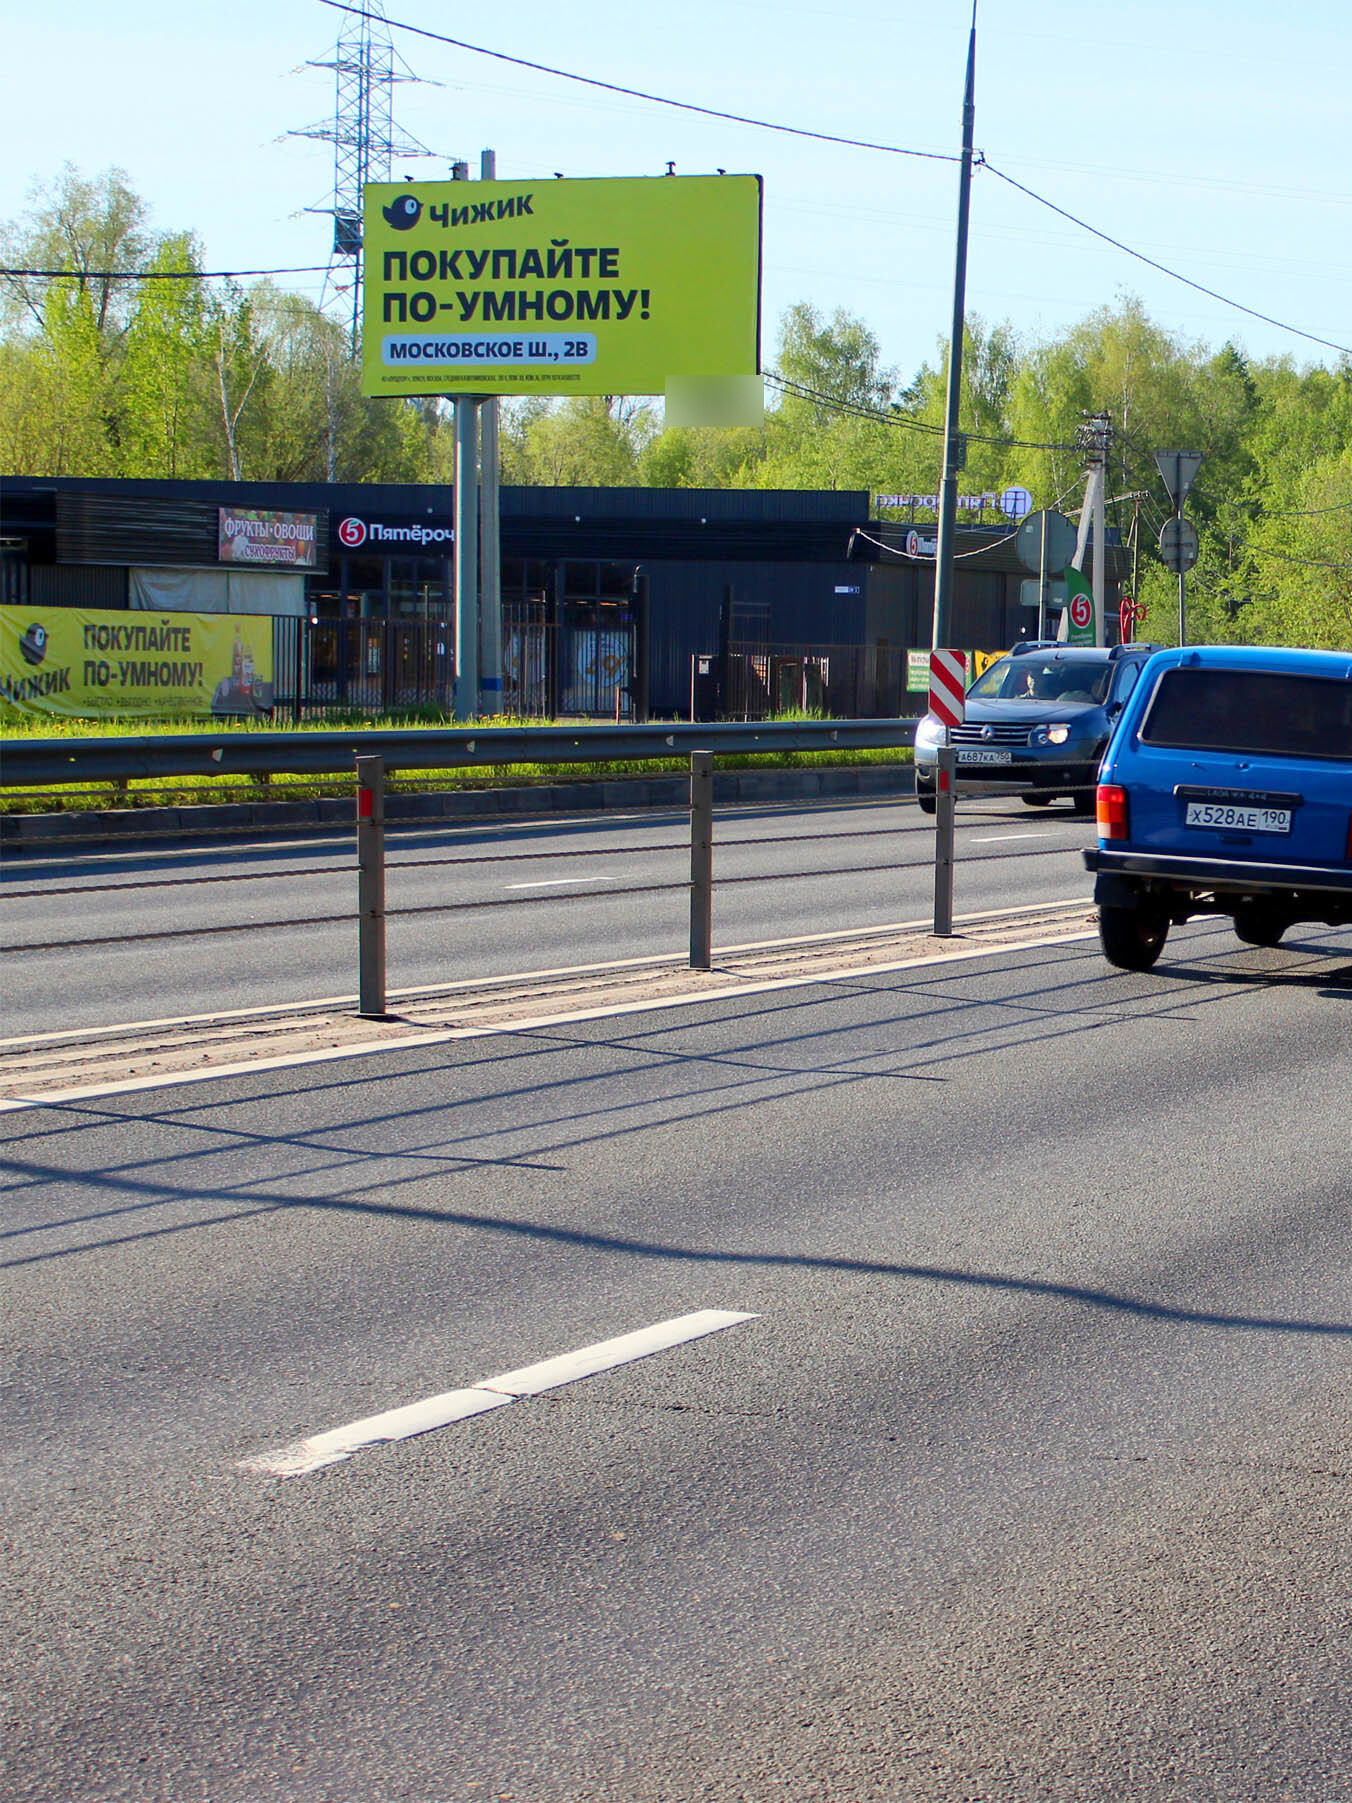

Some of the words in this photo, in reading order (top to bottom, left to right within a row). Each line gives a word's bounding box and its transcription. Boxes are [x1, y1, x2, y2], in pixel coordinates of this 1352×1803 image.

[383, 239, 620, 281] ПОКУПАЙТЕ
[383, 289, 651, 323] ПО-УМНОМУ!
[390, 342, 524, 359] МОСКОВСКОЕ
[528, 341, 559, 361] Ш.,
[564, 341, 588, 358] 2В
[224, 517, 269, 538] ФРУКТЫ
[273, 523, 313, 540] ОВОЩИ
[369, 524, 456, 545] Пятёроч
[84, 619, 191, 652] ПОКУПАЙТЕ
[84, 661, 204, 687] ПО-УМНОМУ!
[1262, 811, 1287, 825] 190
